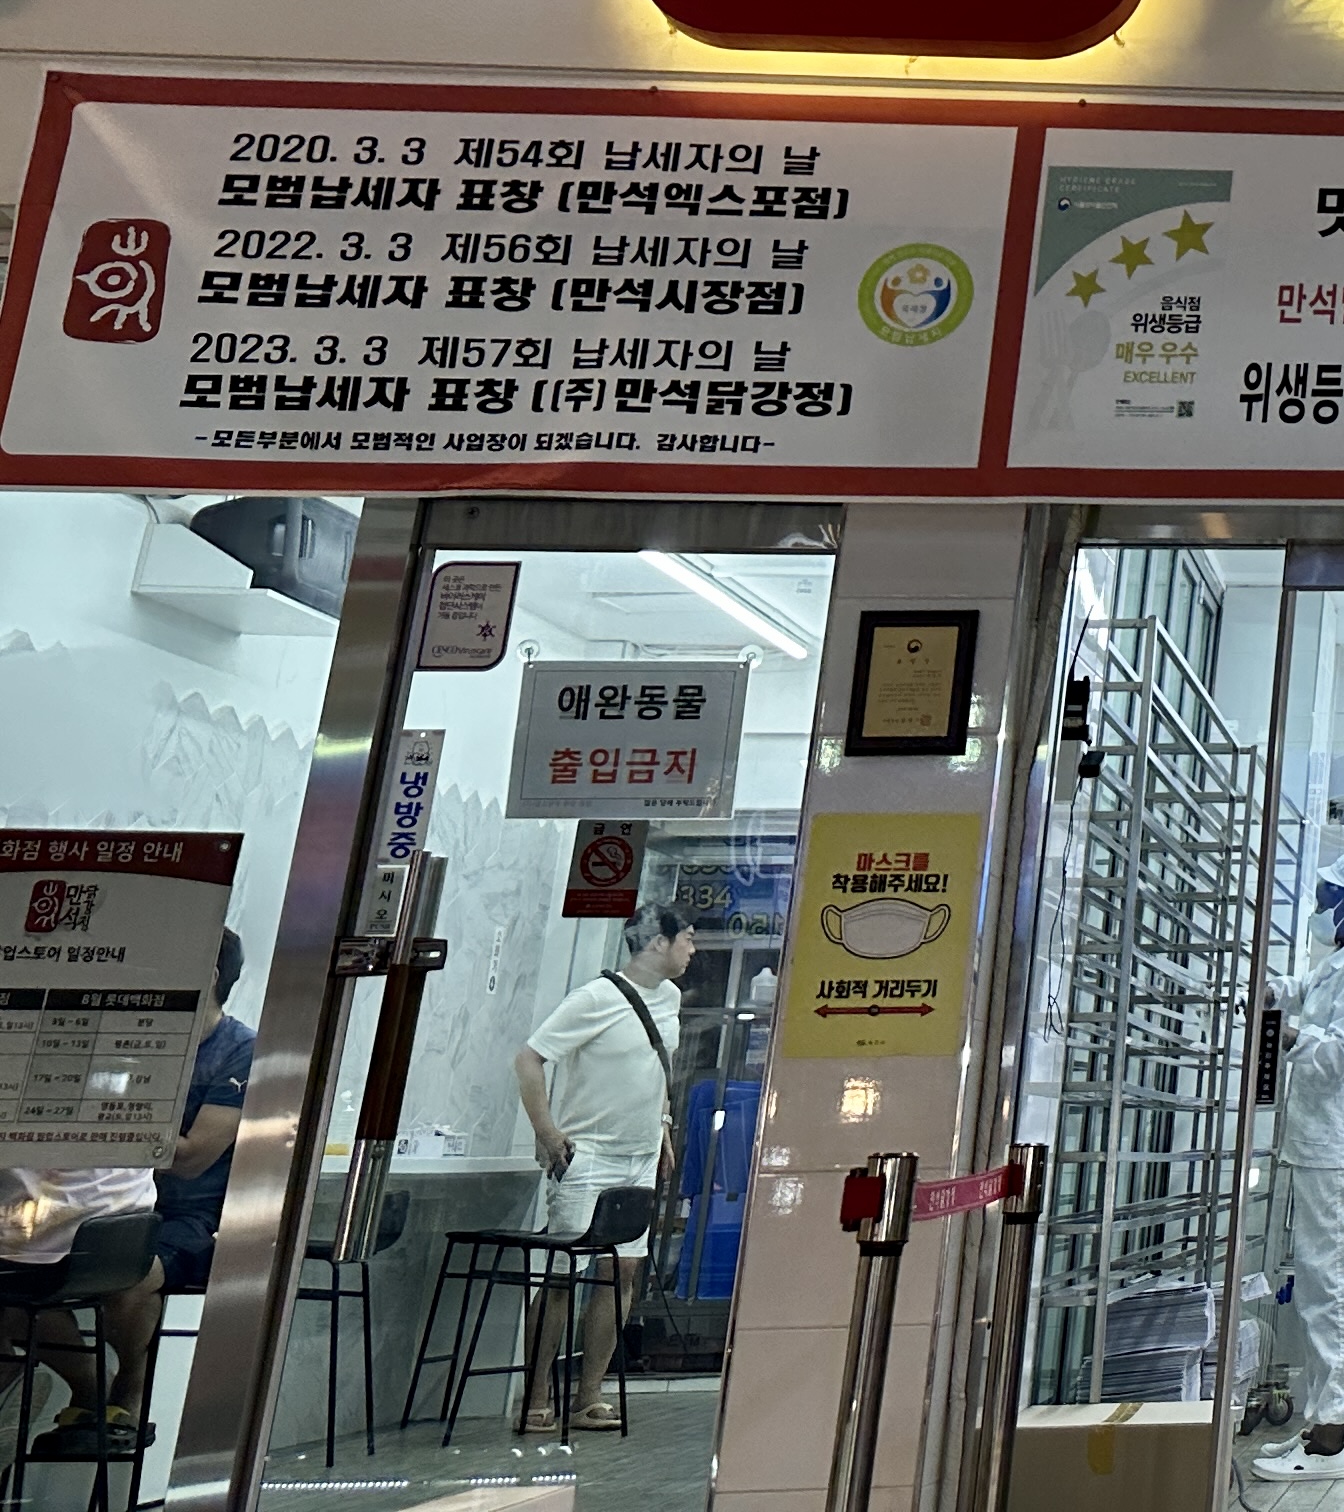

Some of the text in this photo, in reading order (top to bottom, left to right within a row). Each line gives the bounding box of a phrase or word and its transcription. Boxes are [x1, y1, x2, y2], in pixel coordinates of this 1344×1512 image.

[230, 133, 821, 176] 2020. 3. 3 제54회 납세자의 날
[217, 173, 441, 211] 모범납세자
[456, 178, 544, 214] 표창
[213, 229, 809, 269] 2022. 3. 3 제56회 납세자의 날
[197, 270, 429, 309] 모범납세자
[444, 275, 537, 312] 표창
[1160, 295, 1202, 311] 음식점
[1131, 312, 1202, 333] 위생등급
[189, 332, 791, 373] 2023. 3. 3 제57회 납세자의 날
[1115, 340, 1199, 365] 매우 우수
[1122, 370, 1197, 384] EXCELLENT
[179, 374, 411, 412] 모범납세자
[427, 377, 519, 414] 표창
[350, 431, 435, 452] 모범적인
[442, 431, 527, 452] 사업장이
[533, 431, 641, 452] 되겠습니다.
[557, 683, 707, 721] 애완동물
[549, 747, 697, 785] 출입금지
[387, 771, 429, 859] 냉방중
[48, 840, 90, 862] 행사
[96, 841, 136, 863] 일정
[143, 841, 184, 863] 안내
[856, 852, 930, 872] 마스크를
[832, 873, 949, 893] 착용해주세요!
[0, 945, 126, 963] 업스토어 일정안내
[815, 979, 938, 999] 사회적 거리두기
